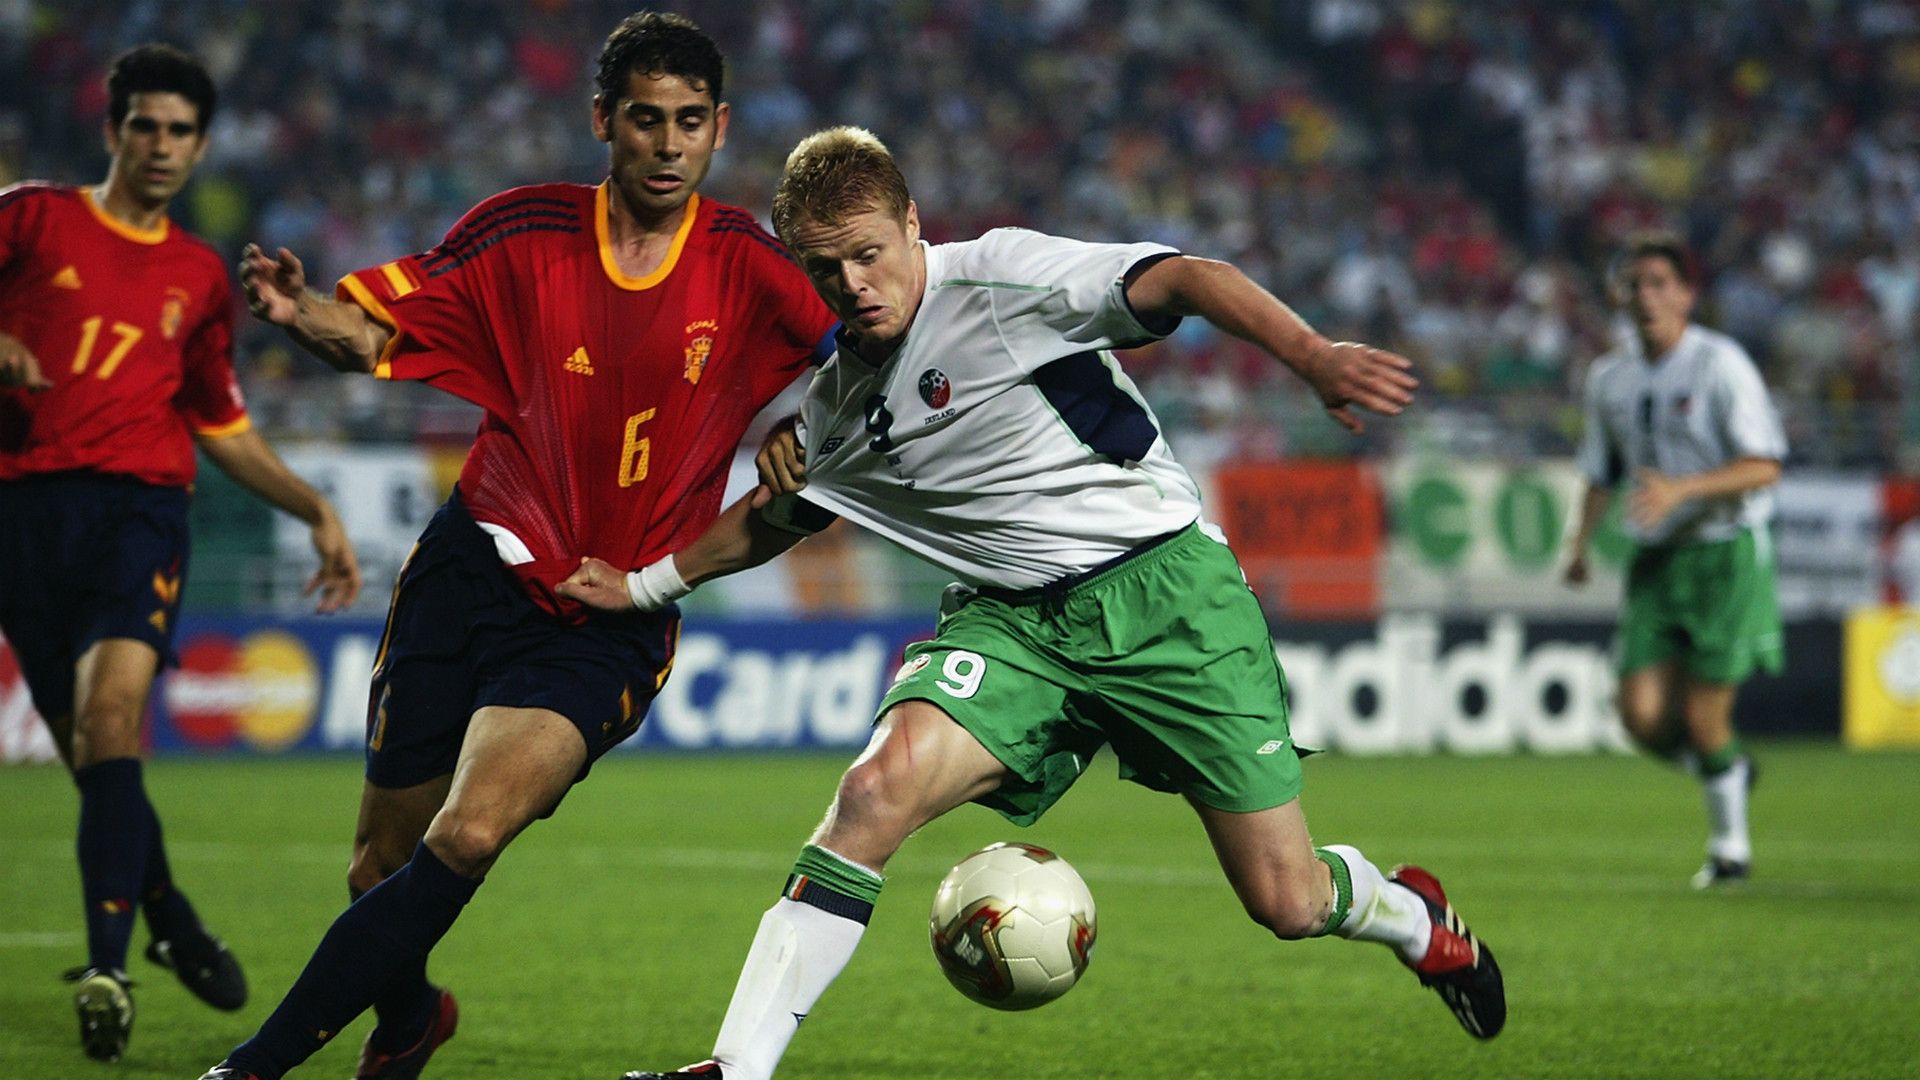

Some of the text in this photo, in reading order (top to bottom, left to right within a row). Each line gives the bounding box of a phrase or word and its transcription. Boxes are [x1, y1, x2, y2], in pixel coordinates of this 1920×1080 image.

[72, 315, 143, 380] 17
[618, 407, 657, 488] 6
[934, 650, 987, 699] 9
